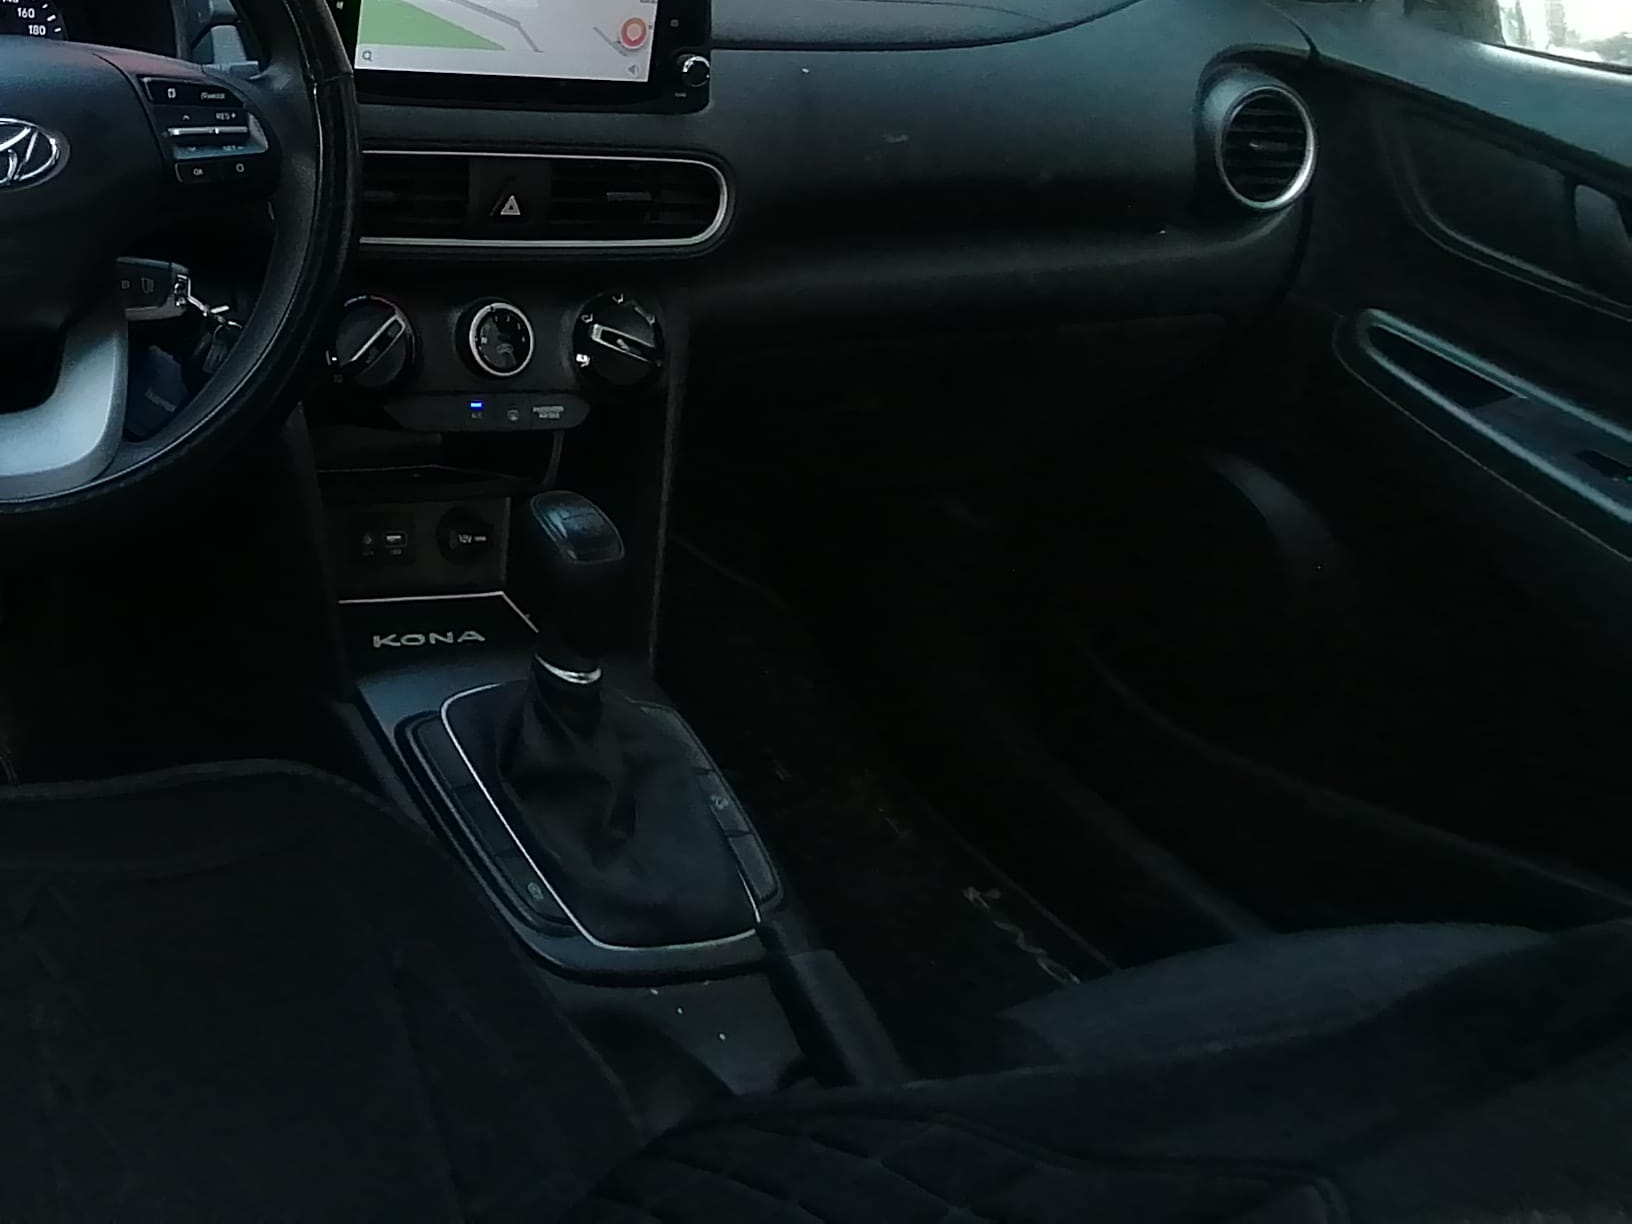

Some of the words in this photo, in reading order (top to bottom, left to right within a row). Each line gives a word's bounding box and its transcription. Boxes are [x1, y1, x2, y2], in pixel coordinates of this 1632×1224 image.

[17, 7, 35, 19] 160
[28, 24, 46, 36] 180
[372, 630, 486, 649] KONA
